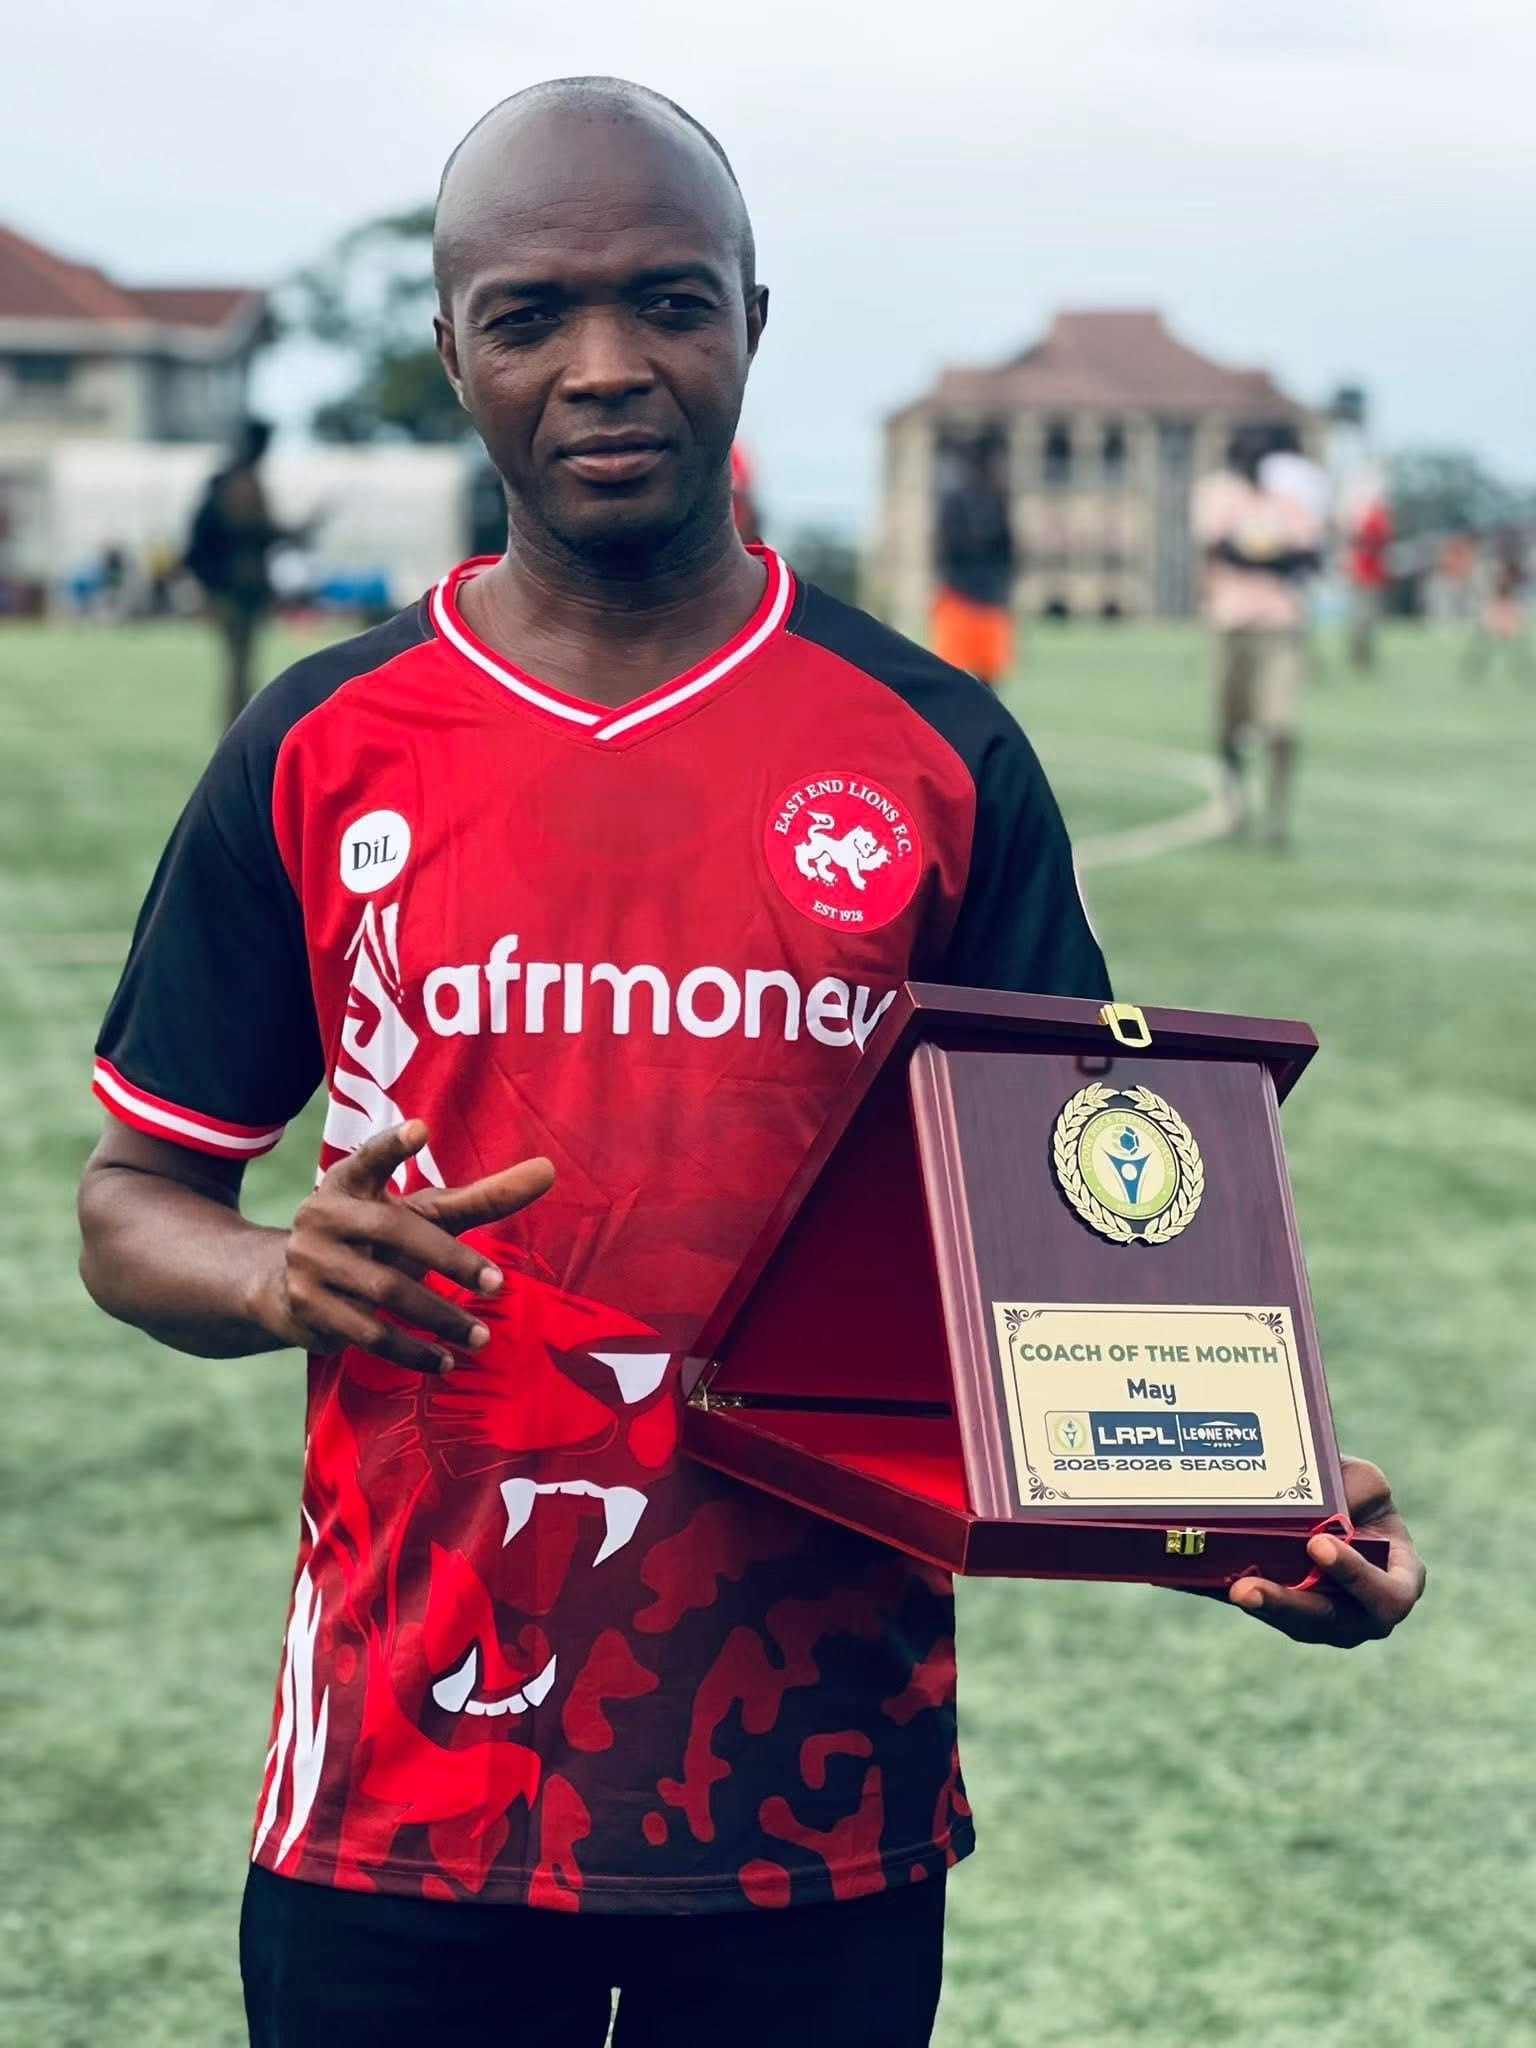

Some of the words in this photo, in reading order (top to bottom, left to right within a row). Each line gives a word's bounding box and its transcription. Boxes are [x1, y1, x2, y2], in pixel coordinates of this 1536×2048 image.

[774, 792, 806, 835] EAST
[805, 779, 844, 799] END
[847, 781, 900, 823] LIONS
[892, 822, 912, 857] F.C.
[351, 834, 398, 871] DiL
[812, 900, 837, 919] EST
[839, 909, 864, 923] 1928
[422, 933, 897, 1054] afrimoney
[1019, 1343, 1102, 1362] COACH
[1109, 1344, 1139, 1362] OF
[1145, 1345, 1190, 1362] THE
[1196, 1345, 1279, 1364] MONTH
[1126, 1378, 1177, 1405] May
[1098, 1425, 1176, 1446] LRPL
[1182, 1427, 1224, 1441] LEONE
[1225, 1427, 1259, 1441] ROCK
[1053, 1458, 1173, 1472] 2025-2026
[1179, 1458, 1268, 1472] SEASON
